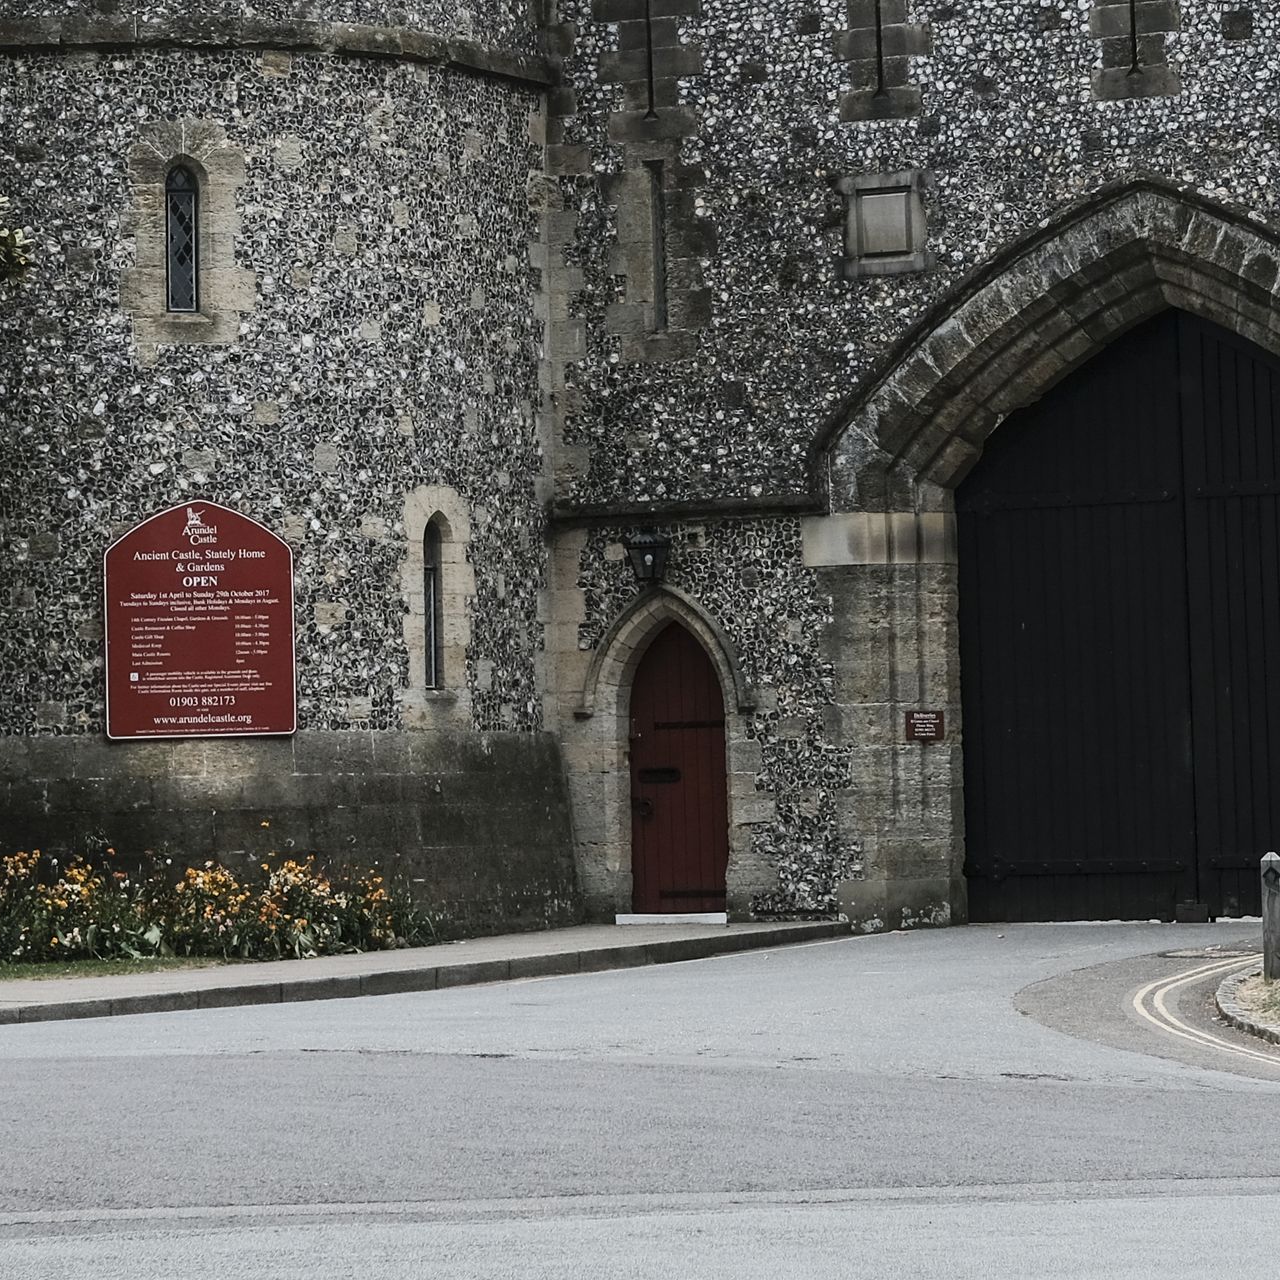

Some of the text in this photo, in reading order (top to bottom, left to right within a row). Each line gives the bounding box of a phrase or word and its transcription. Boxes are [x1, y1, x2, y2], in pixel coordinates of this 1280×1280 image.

[182, 526, 217, 536] Arundel
[190, 535, 218, 545] Castle
[133, 549, 266, 560] Ancient Castle, Stately Home
[175, 562, 225, 572] & Gardens
[182, 576, 218, 587] OPEN
[130, 592, 157, 600] Saturday
[169, 591, 184, 600] April
[193, 591, 214, 599] Sunday
[169, 696, 235, 707] 01903 882173
[153, 713, 252, 724] www.arundelcastle.org
